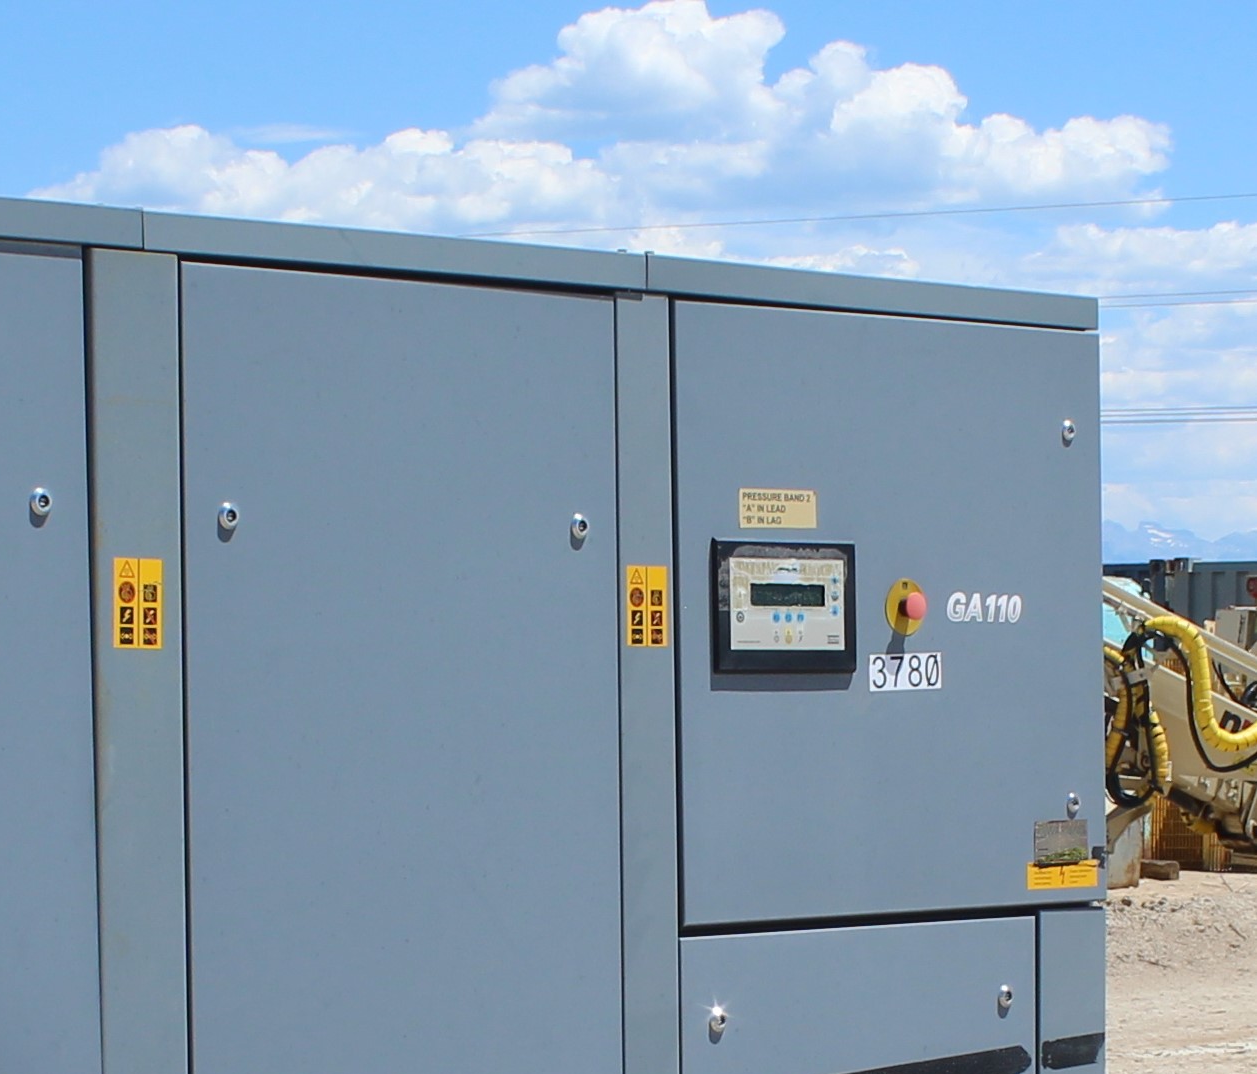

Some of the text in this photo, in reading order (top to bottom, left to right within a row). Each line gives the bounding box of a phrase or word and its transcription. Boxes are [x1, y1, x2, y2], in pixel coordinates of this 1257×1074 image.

[742, 492, 783, 502] PRESSURE
[783, 493, 805, 502] BAND
[757, 504, 765, 512] IN
[766, 505, 786, 513] LEAD
[757, 516, 765, 524] IN
[766, 516, 782, 525] LAG
